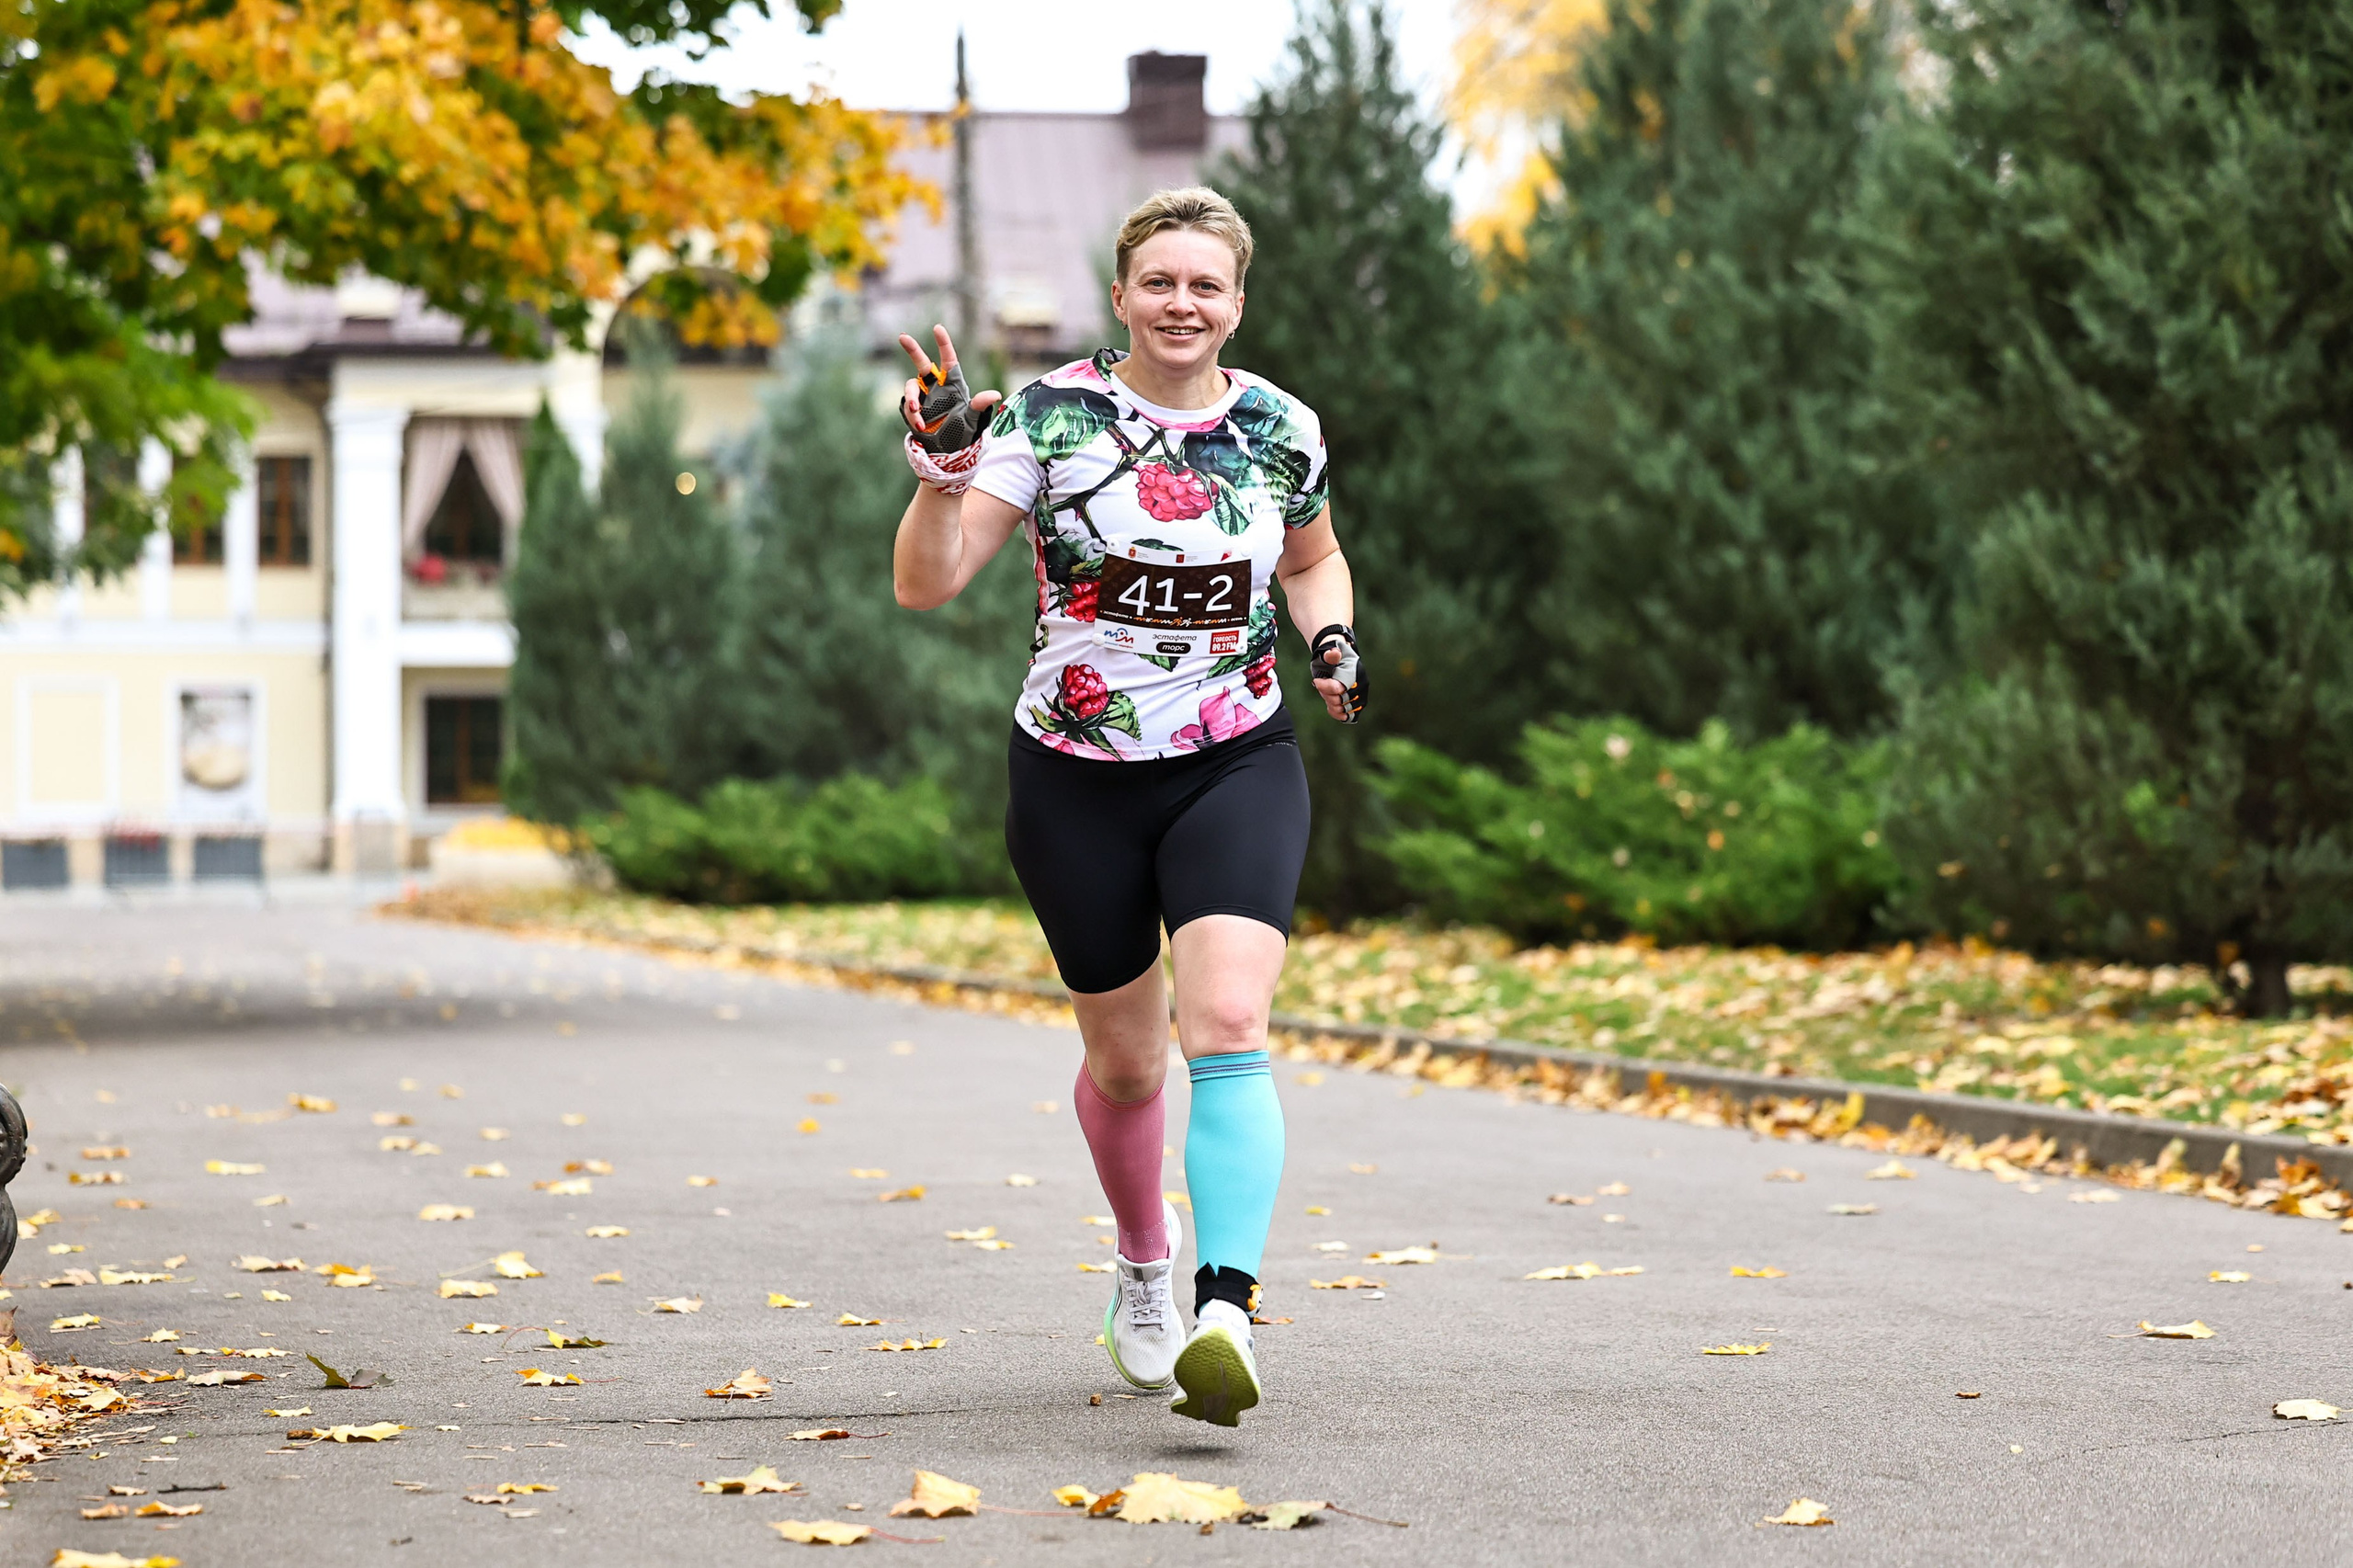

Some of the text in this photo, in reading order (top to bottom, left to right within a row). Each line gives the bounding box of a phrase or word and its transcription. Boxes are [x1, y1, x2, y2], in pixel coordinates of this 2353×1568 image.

[1118, 574, 1233, 616] 41-2
[1153, 633, 1198, 642] эстафета
[1211, 643, 1225, 652] 89.2
